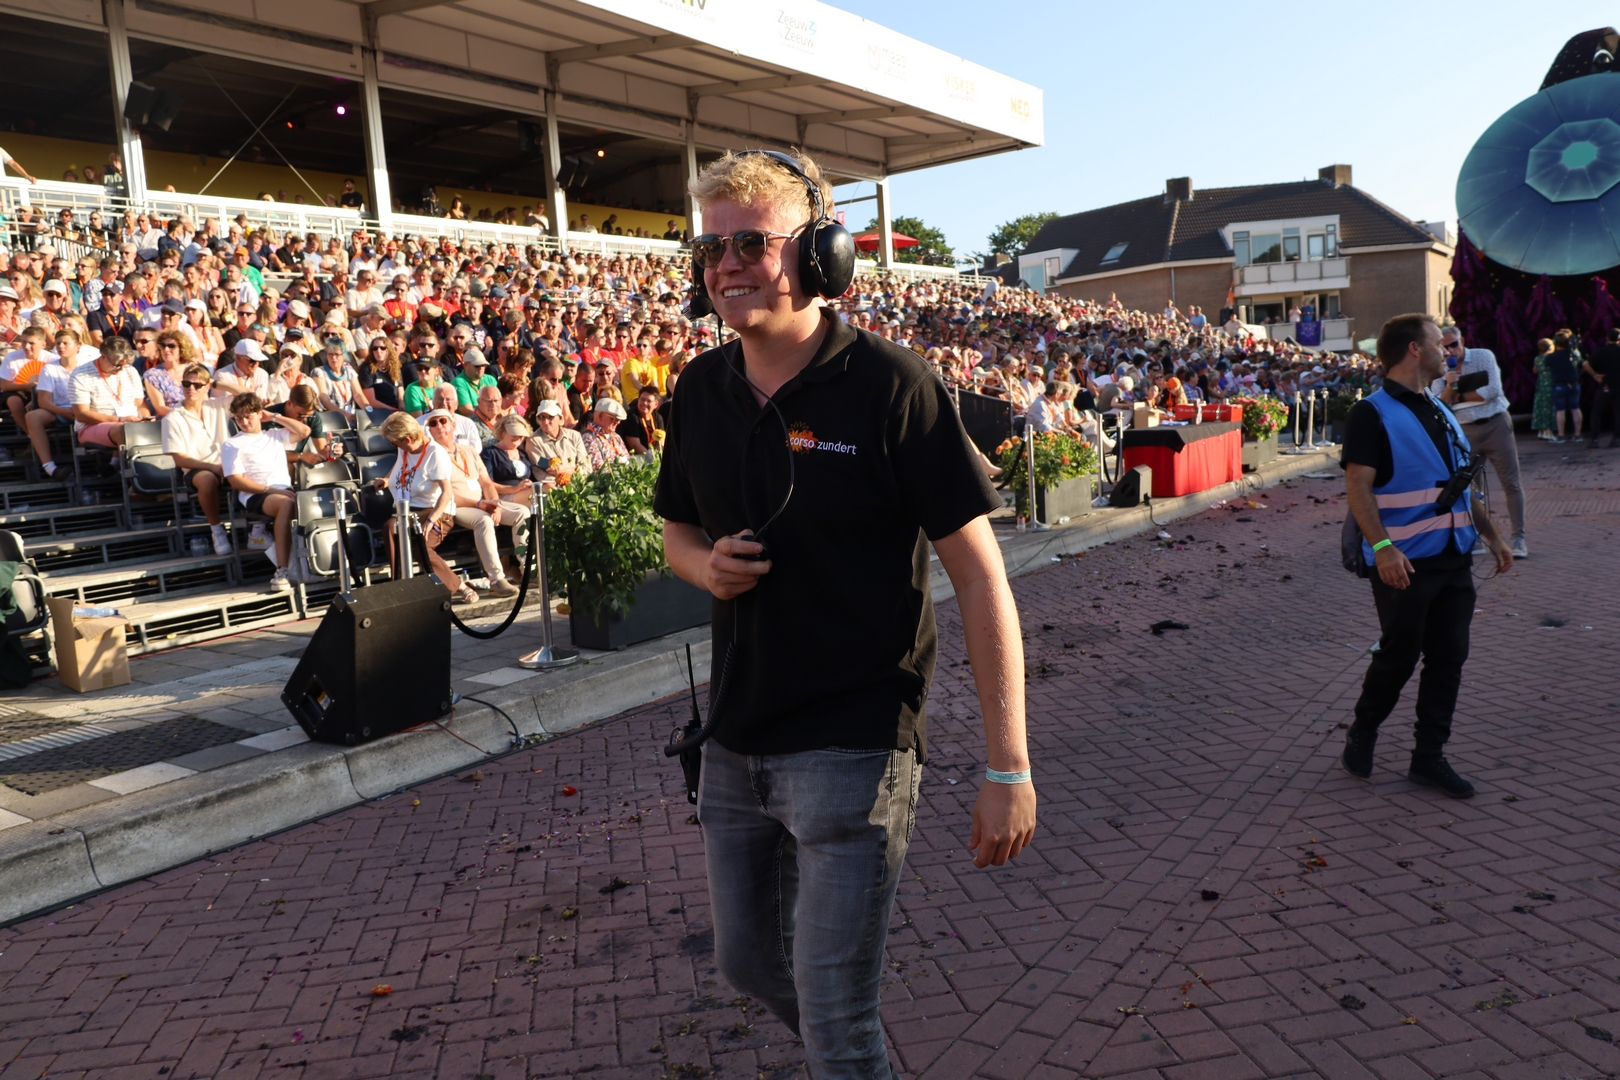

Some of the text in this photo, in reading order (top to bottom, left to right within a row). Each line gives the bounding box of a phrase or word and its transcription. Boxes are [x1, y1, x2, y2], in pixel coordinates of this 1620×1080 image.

[777, 9, 808, 31] Zeeuw
[784, 26, 815, 48] Zeeuw
[882, 48, 906, 68] maas
[943, 72, 976, 96] VISKER
[789, 437, 857, 455] corso zundert
